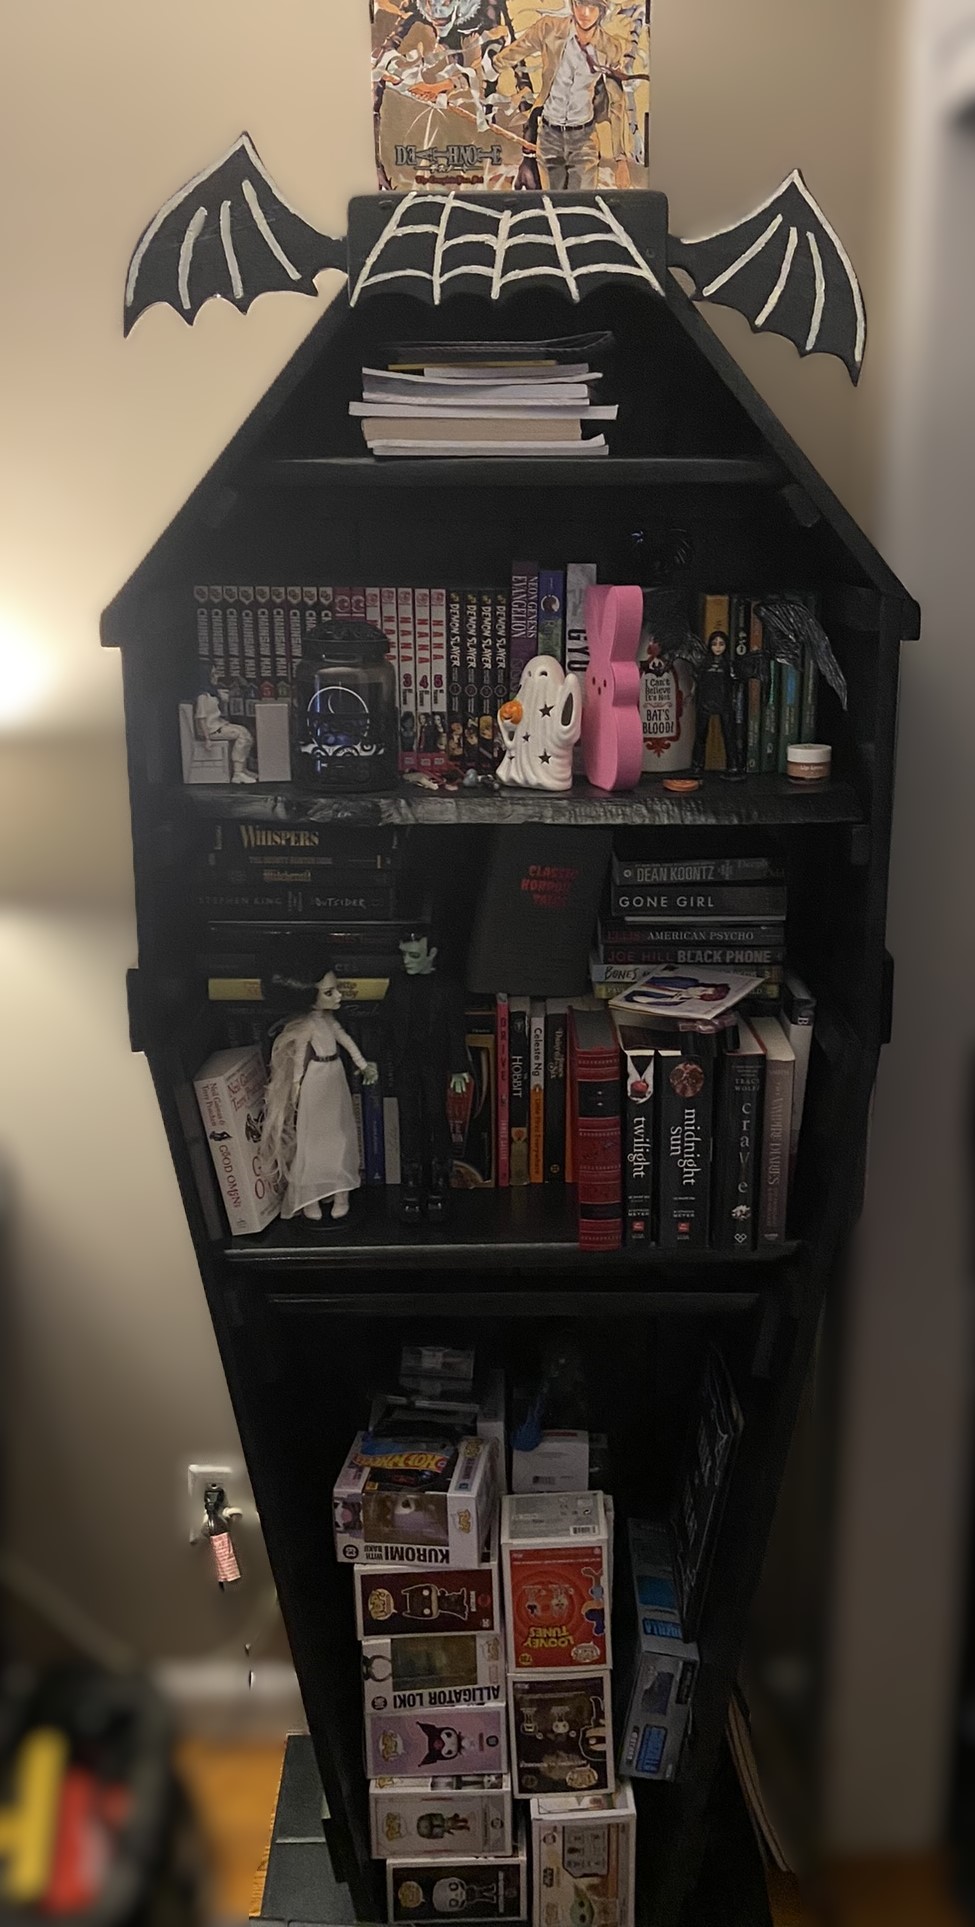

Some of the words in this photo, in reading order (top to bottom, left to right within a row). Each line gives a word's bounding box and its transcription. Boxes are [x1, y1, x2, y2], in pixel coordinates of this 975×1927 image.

[528, 576, 538, 600] NEON
[450, 603, 460, 634] DEMON
[466, 605, 477, 635] DEMON
[511, 576, 527, 638] EVANGELION
[527, 602, 538, 638] GENESIS
[481, 606, 491, 636] DEMON
[496, 605, 506, 636] DEMON
[400, 617, 412, 662] NANA
[417, 619, 430, 664] NANA
[432, 620, 444, 660] NANA
[450, 635, 461, 668] SLAYER
[466, 637, 477, 669] SLAYER
[481, 638, 492, 670] SLAYER
[496, 638, 507, 669] SLAYER
[402, 673, 412, 687] 3
[419, 675, 429, 688] 4
[433, 674, 444, 688] 5
[650, 678, 670, 686] Can't
[643, 721, 674, 734] BLOOD!
[646, 709, 670, 721] BAT'S
[240, 824, 320, 848] WHISPERS
[636, 867, 667, 882] DEAN
[670, 866, 715, 881] KOONTZ
[618, 896, 668, 908] GONE
[676, 896, 714, 908] GIRL
[647, 931, 706, 941] AMERICAN
[709, 931, 754, 941] PSYCHO
[608, 952, 634, 962] JOE
[677, 950, 723, 963] BLACK
[726, 950, 772, 963] PHONE
[604, 966, 638, 981] BONES
[534, 1027, 543, 1060] Celeste
[511, 1056, 523, 1098] HOBBIT
[532, 1063, 542, 1076] Ng
[627, 1116, 651, 1179] twilight
[670, 1126, 683, 1157] sun
[677, 1108, 702, 1186] midnight
[218, 1144, 233, 1173] GOOD
[385, 1548, 450, 1564] KUROMI
[522, 1637, 575, 1649] LOONEY
[528, 1625, 570, 1637] TUNES
[393, 1693, 424, 1709] LOKI
[428, 1685, 500, 1705] ALLIGATOR
